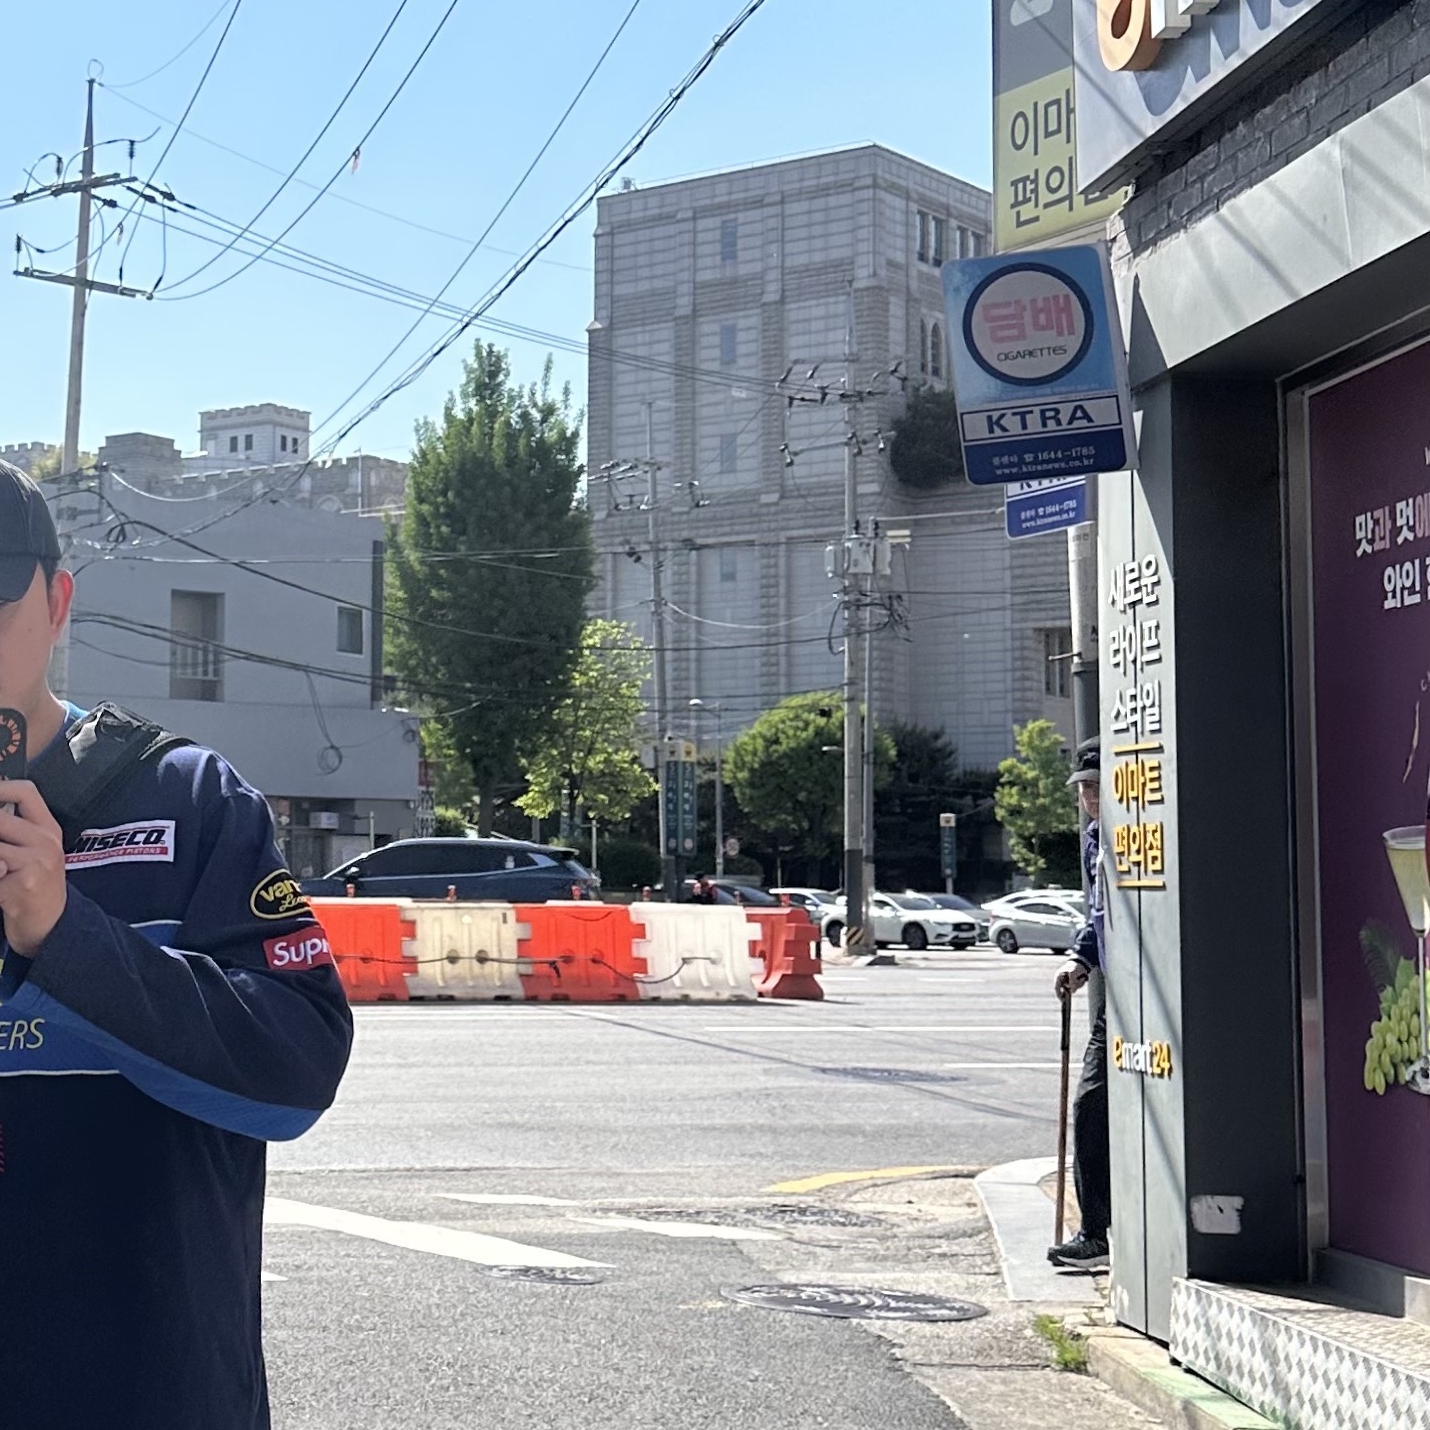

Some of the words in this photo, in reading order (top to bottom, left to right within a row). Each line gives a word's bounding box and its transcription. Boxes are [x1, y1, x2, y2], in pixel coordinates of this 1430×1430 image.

[1010, 156, 1101, 229] 편의
[981, 293, 1076, 345] 담배
[997, 345, 1068, 362] CIGARETTES
[986, 404, 1095, 435] KTRA
[1037, 446, 1095, 461] 1644-1785
[1355, 506, 1391, 557] 맛과
[1108, 554, 1160, 612] 새로운
[1383, 558, 1421, 610] 와인
[1109, 619, 1161, 673] 라이프
[1110, 679, 1161, 735] 스타일
[1113, 760, 1162, 810] 이마트
[1113, 823, 1163, 875] 편의점
[259, 876, 302, 903] van
[1113, 1036, 1171, 1077] emart24
